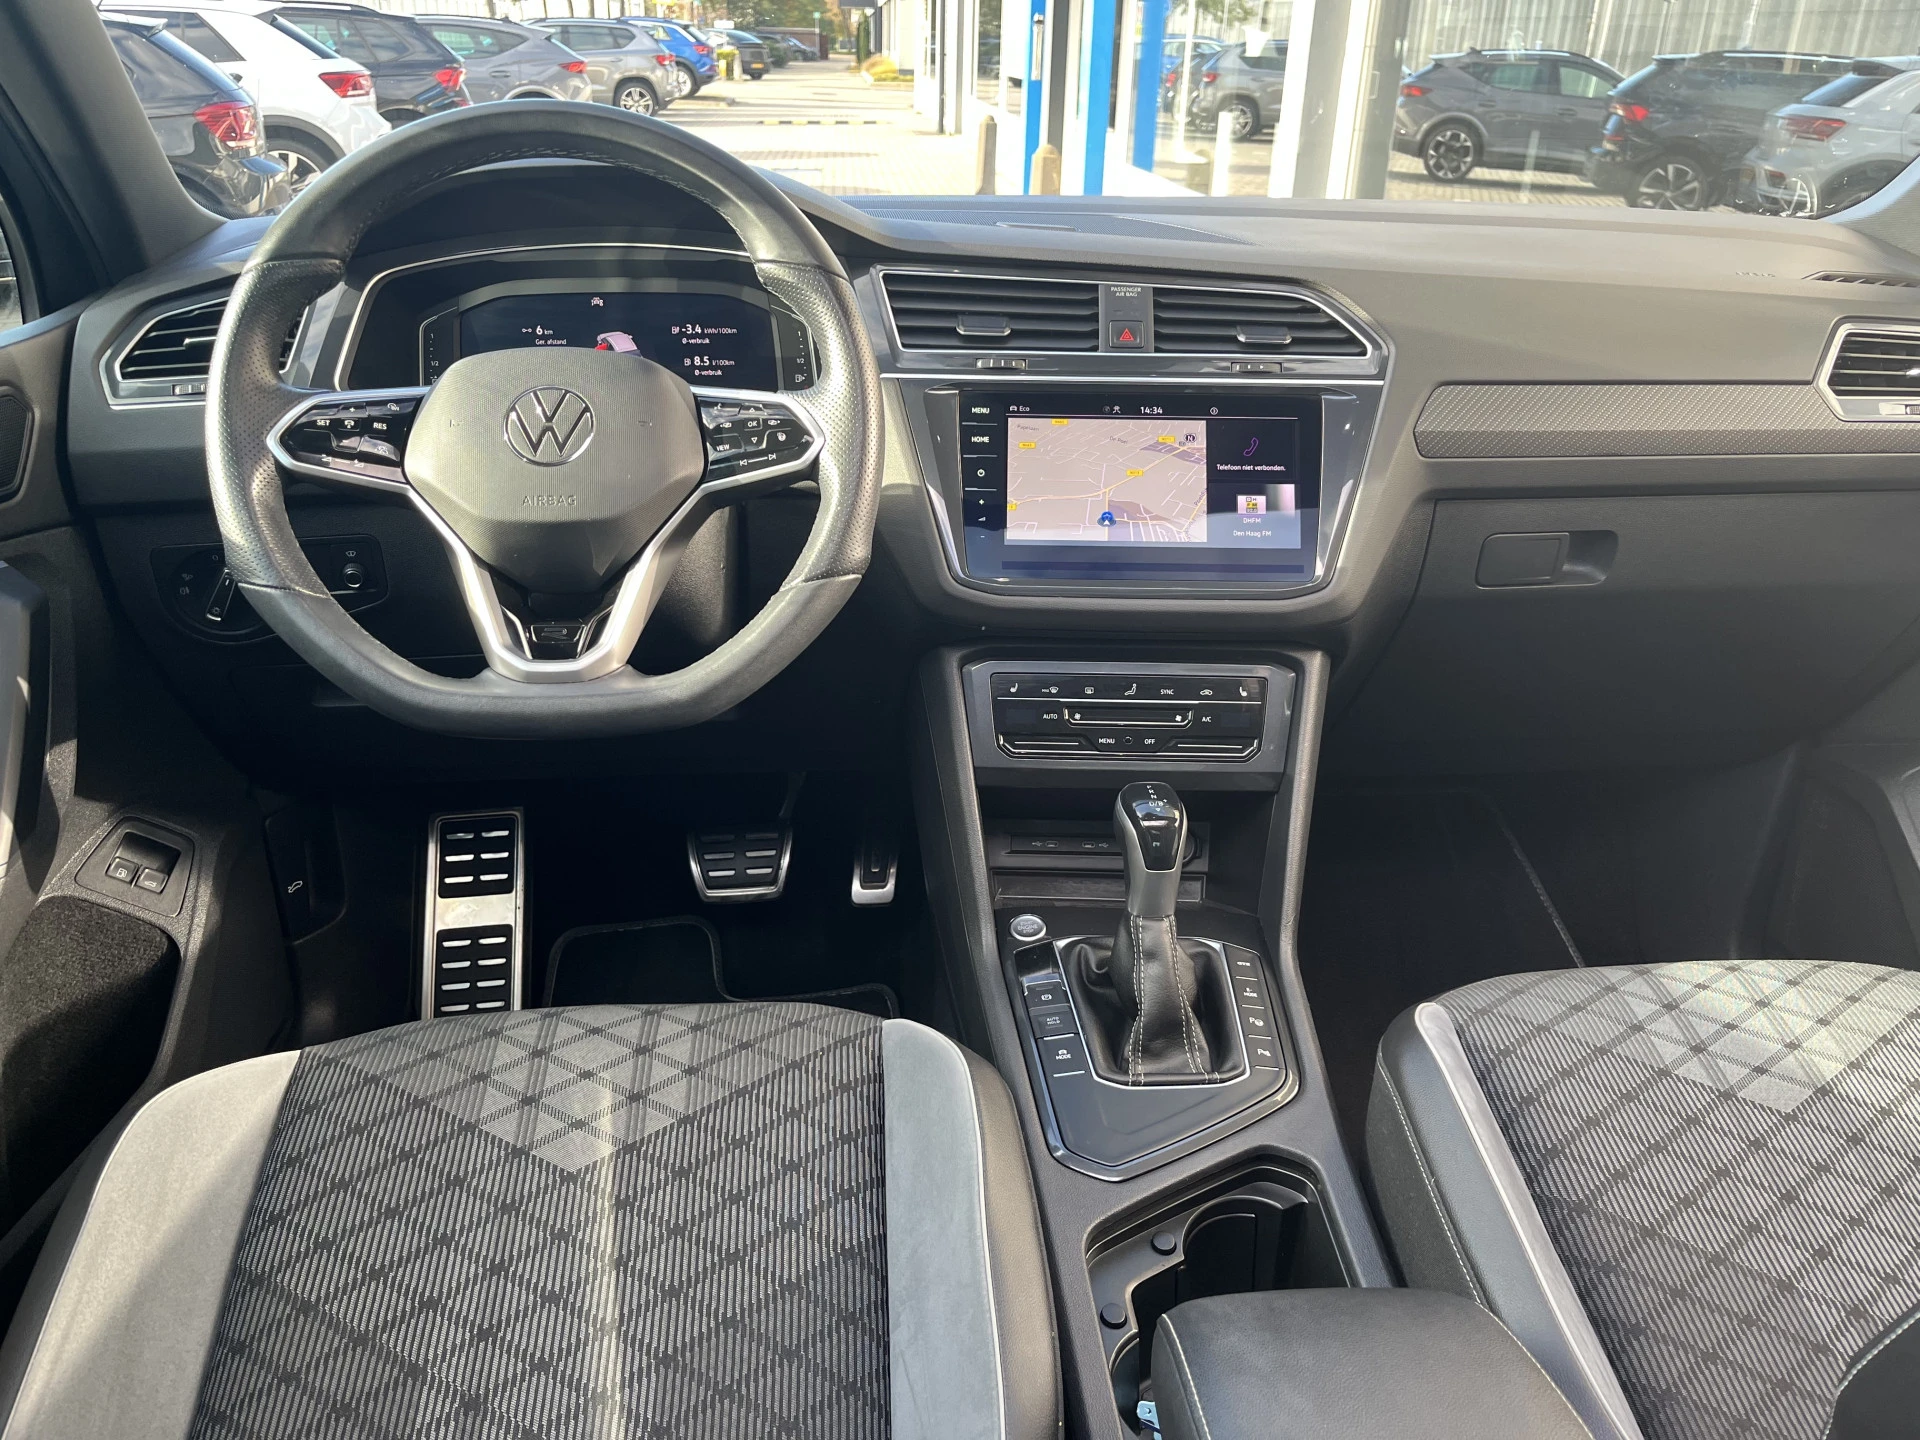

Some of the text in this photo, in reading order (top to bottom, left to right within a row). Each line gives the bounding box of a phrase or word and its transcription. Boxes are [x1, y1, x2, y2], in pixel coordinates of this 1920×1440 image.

[536, 325, 543, 335] 6
[681, 324, 702, 334] -3.4
[693, 356, 710, 366] 8.5
[1140, 406, 1163, 414] 14:34
[373, 422, 388, 430] RES
[522, 494, 577, 507] AIRBAG
